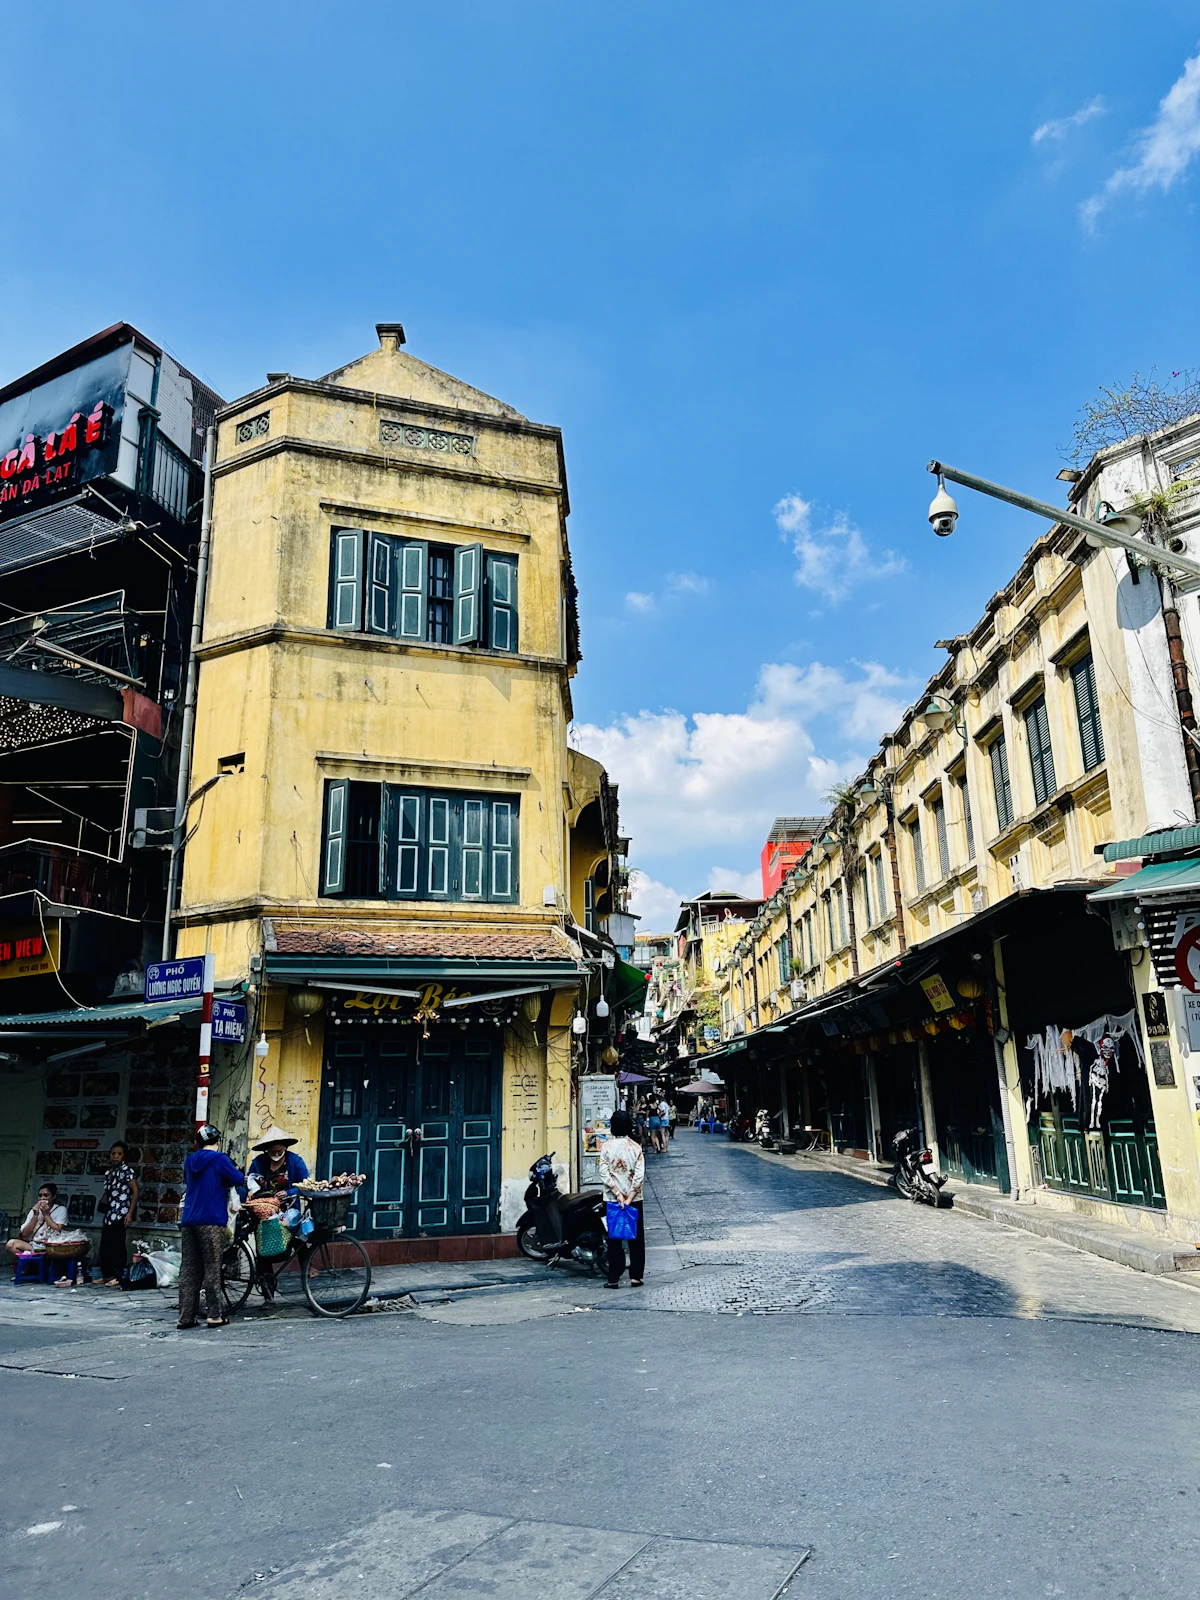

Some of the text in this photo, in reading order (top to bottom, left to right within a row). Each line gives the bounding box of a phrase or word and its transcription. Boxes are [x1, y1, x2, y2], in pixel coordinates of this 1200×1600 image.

[44, 412, 80, 461] LÁ
[85, 400, 104, 443] É
[15, 936, 43, 958] VIEW
[165, 963, 186, 976] PHỐ
[148, 980, 167, 997] LƯƠNG
[167, 979, 182, 996] NGỌC
[223, 1006, 236, 1018] PHỐ
[215, 1018, 242, 1038] TẠ HIỆN
